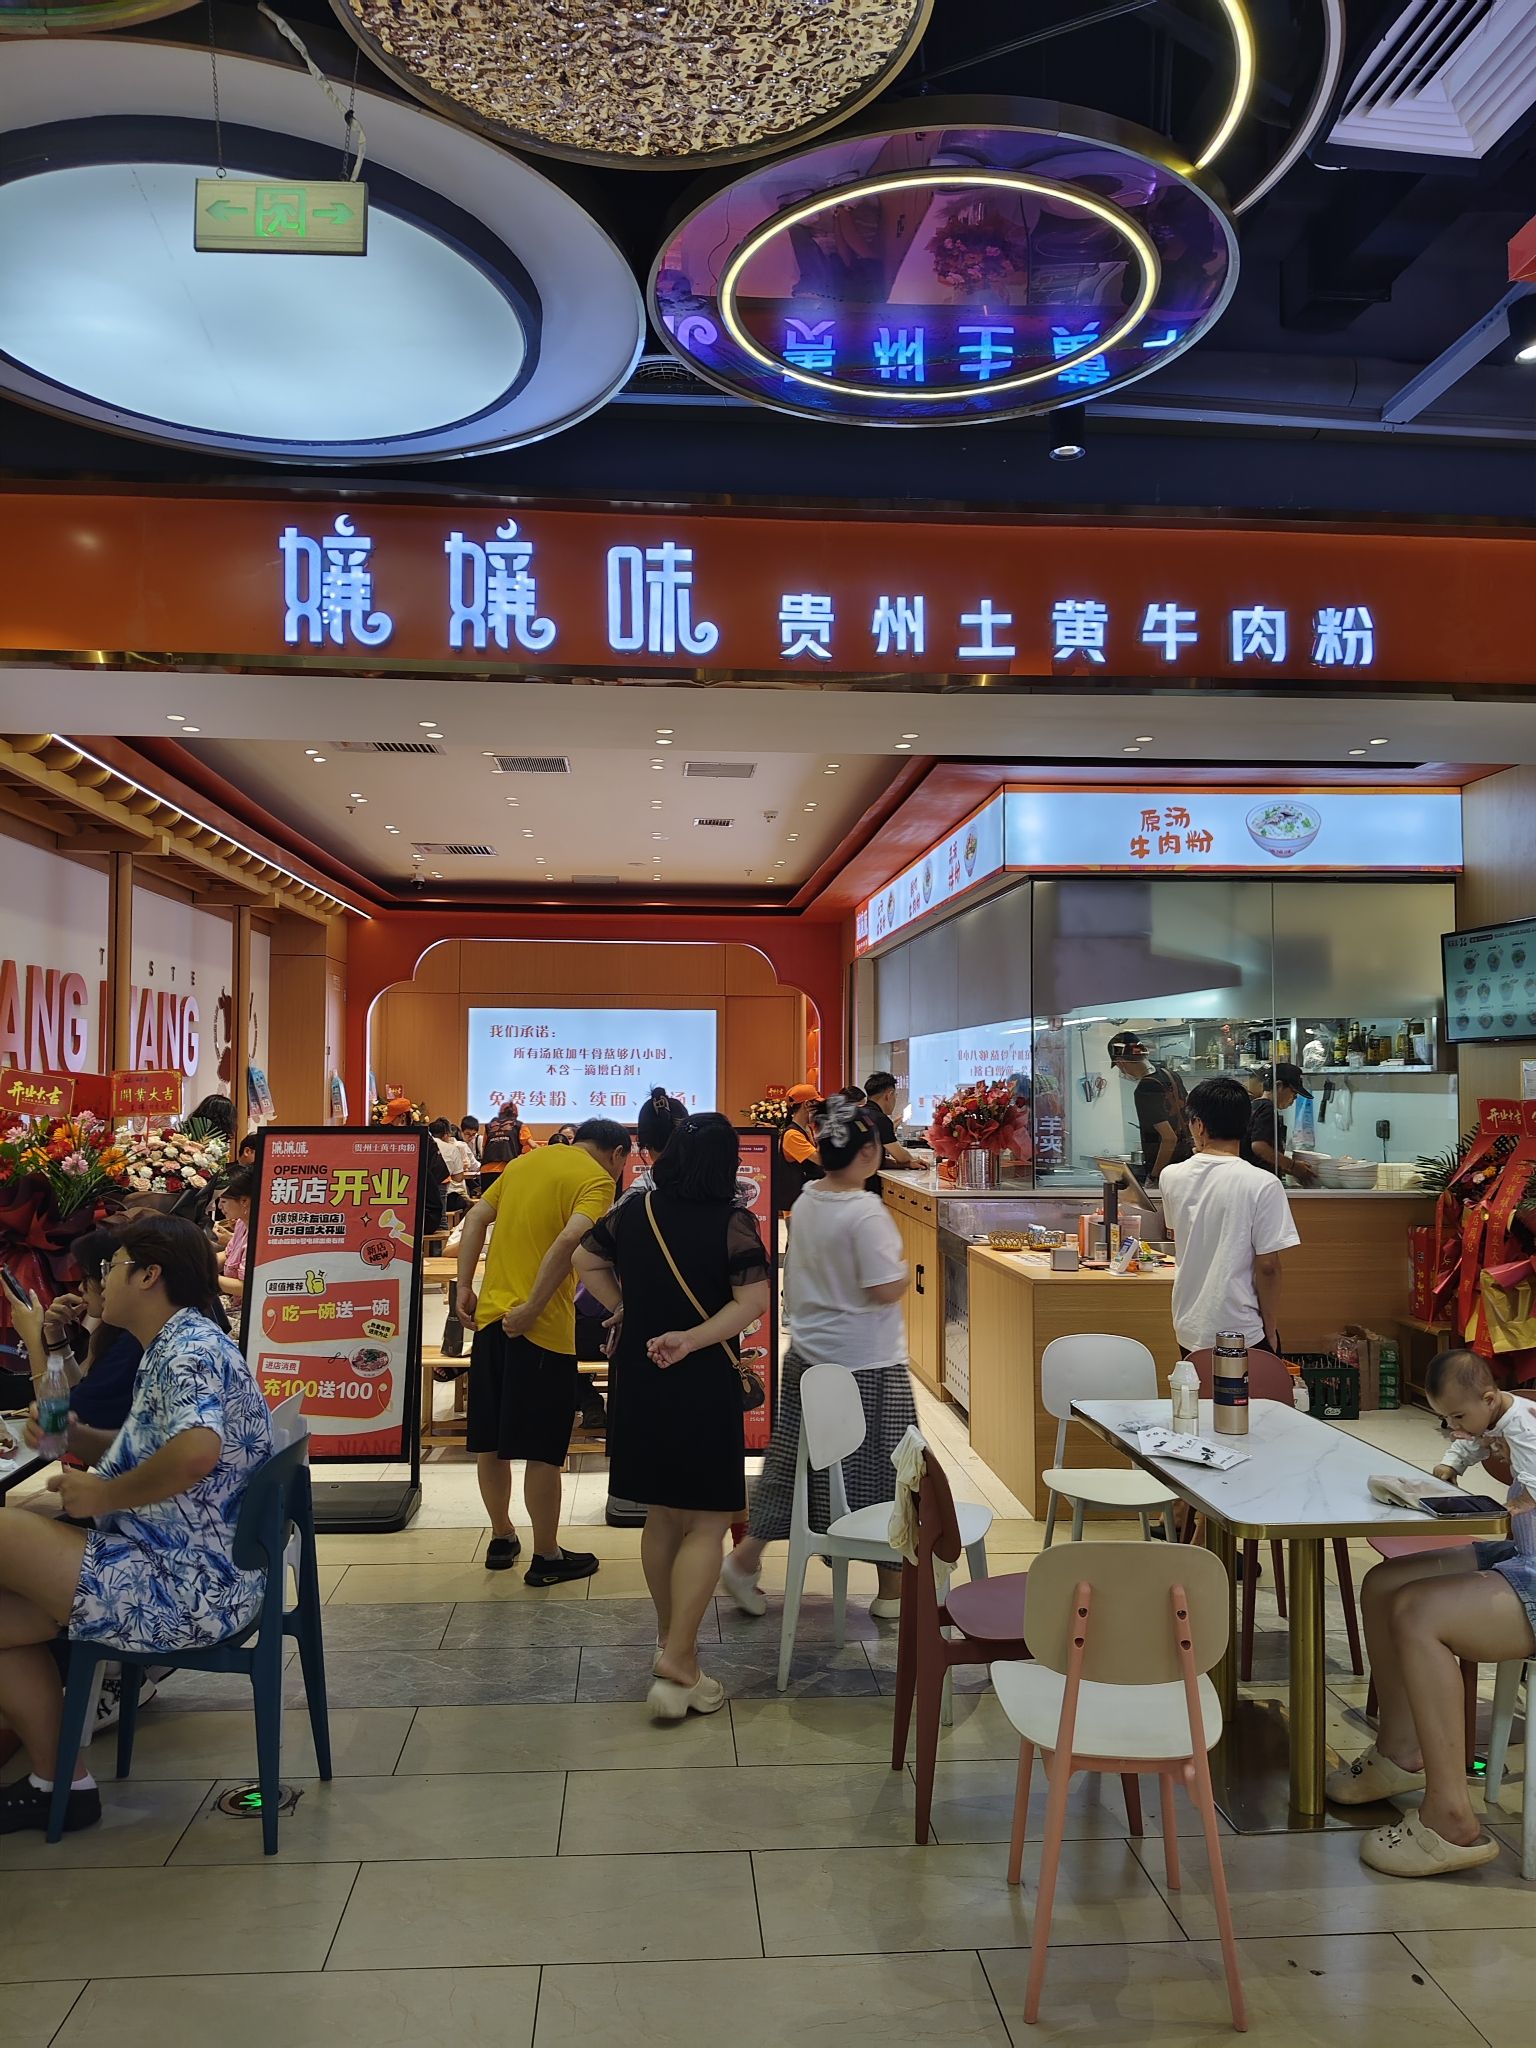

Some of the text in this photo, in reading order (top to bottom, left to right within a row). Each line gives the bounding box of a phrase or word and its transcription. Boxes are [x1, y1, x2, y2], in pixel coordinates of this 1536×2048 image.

[778, 593, 1376, 667] 贵州土黄牛肉粉
[1140, 806, 1191, 832] 原汤
[1129, 829, 1214, 859] 牛肉粉
[99, 947, 196, 986] TSTE
[119, 1086, 174, 1104] 開業大吉
[354, 1142, 416, 1153] 贵州土黄牛肉粉
[273, 1164, 328, 1175] OPENING
[268, 1225, 346, 1236] 7月25日盛大开业
[368, 1251, 389, 1263] NEW
[268, 1282, 304, 1291] 超值推荐
[282, 1298, 390, 1322] 吃一碗送一碗
[265, 1361, 297, 1371] 进店消费
[262, 1378, 373, 1400] 充100送100
